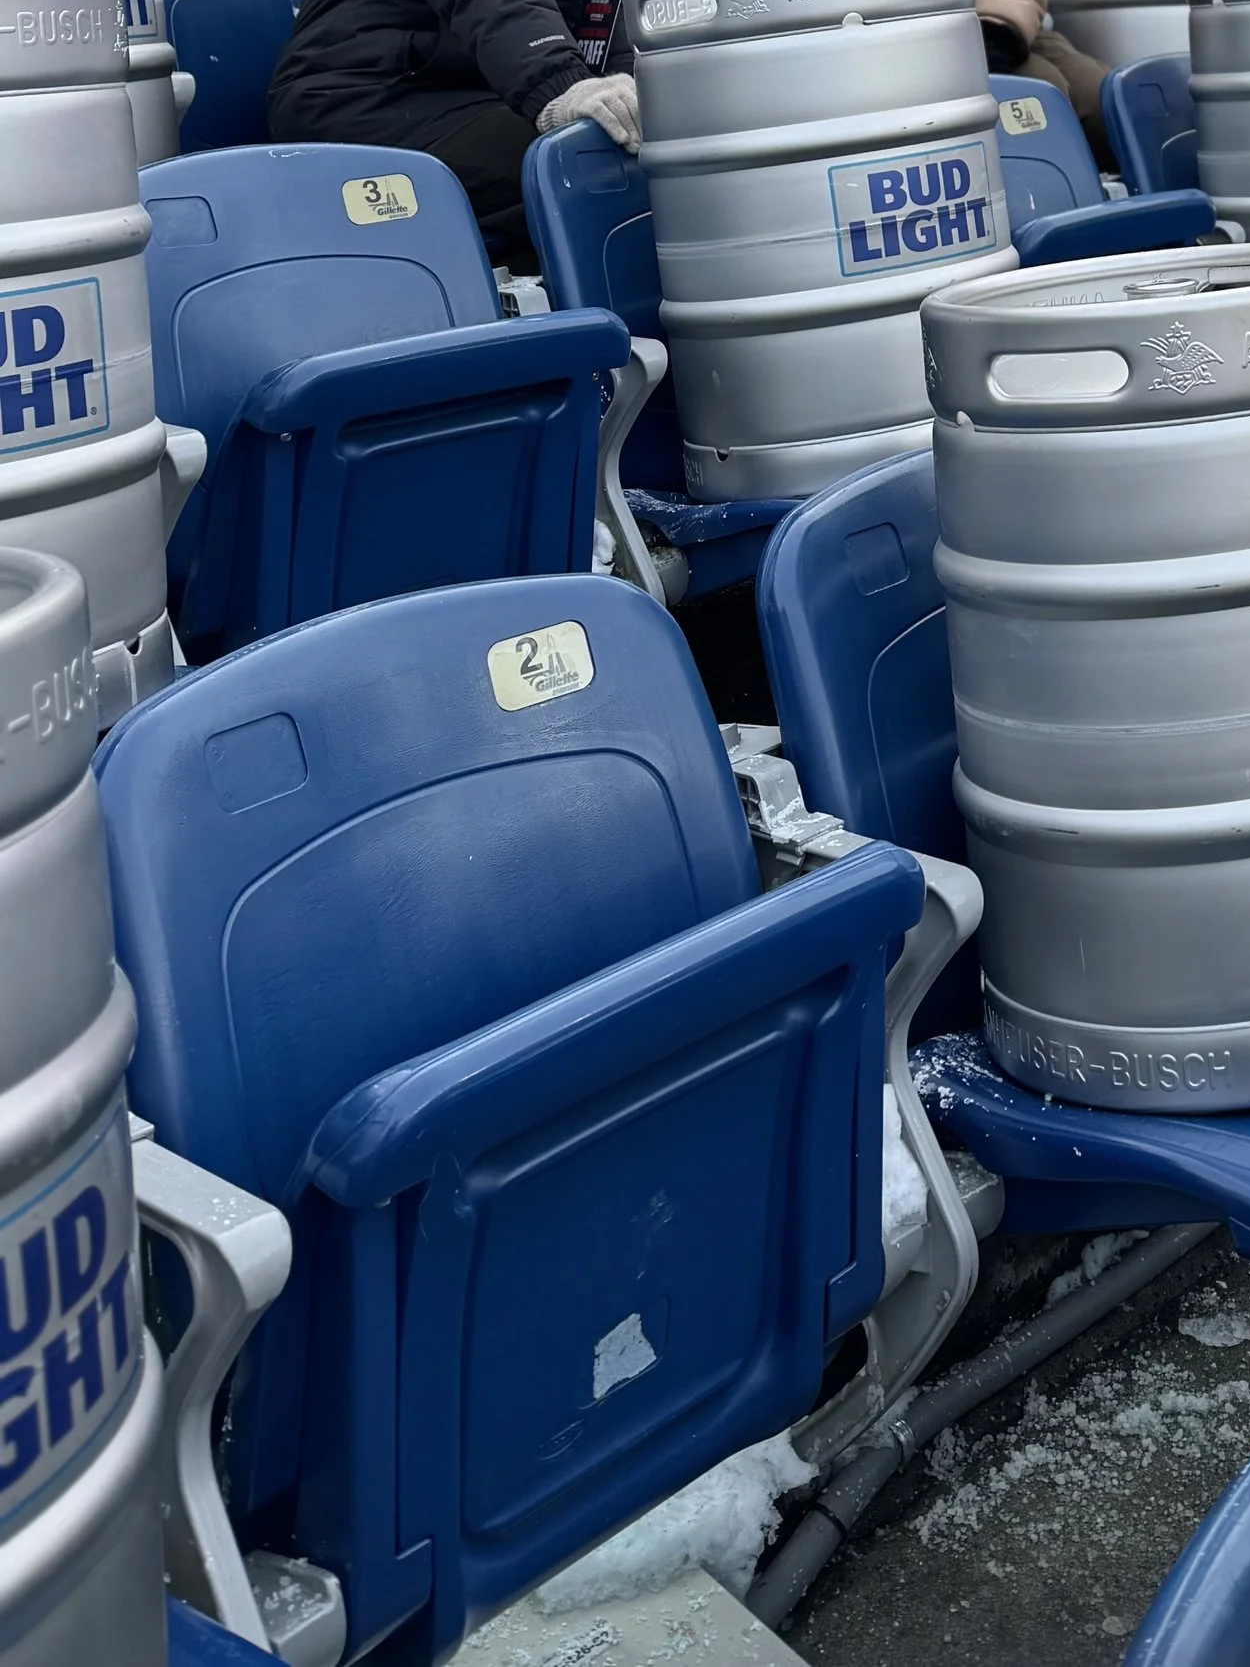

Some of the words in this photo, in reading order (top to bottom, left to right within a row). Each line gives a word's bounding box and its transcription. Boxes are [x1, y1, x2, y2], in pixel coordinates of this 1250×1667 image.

[1010, 101, 1023, 119] 5
[362, 180, 382, 204] 3
[866, 157, 971, 215] BUD
[377, 204, 409, 216] Gillette
[848, 197, 988, 264] LIGHT
[515, 636, 543, 676] 2
[535, 670, 580, 693] Gillette
